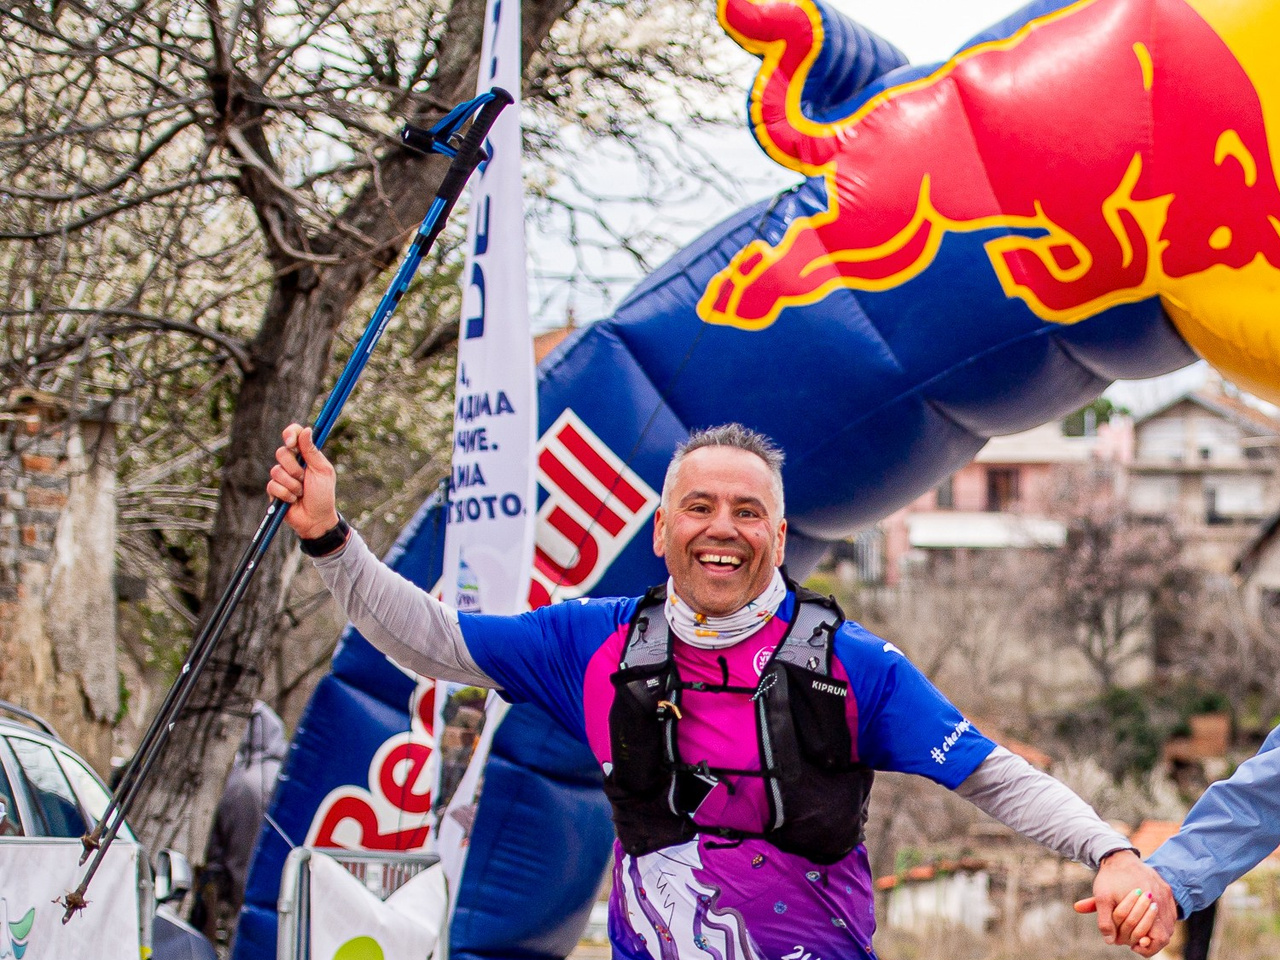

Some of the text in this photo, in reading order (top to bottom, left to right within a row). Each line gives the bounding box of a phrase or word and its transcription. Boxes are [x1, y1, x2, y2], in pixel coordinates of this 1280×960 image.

[313, 423, 648, 851] Re ull
[812, 680, 848, 697] KIPRUN
